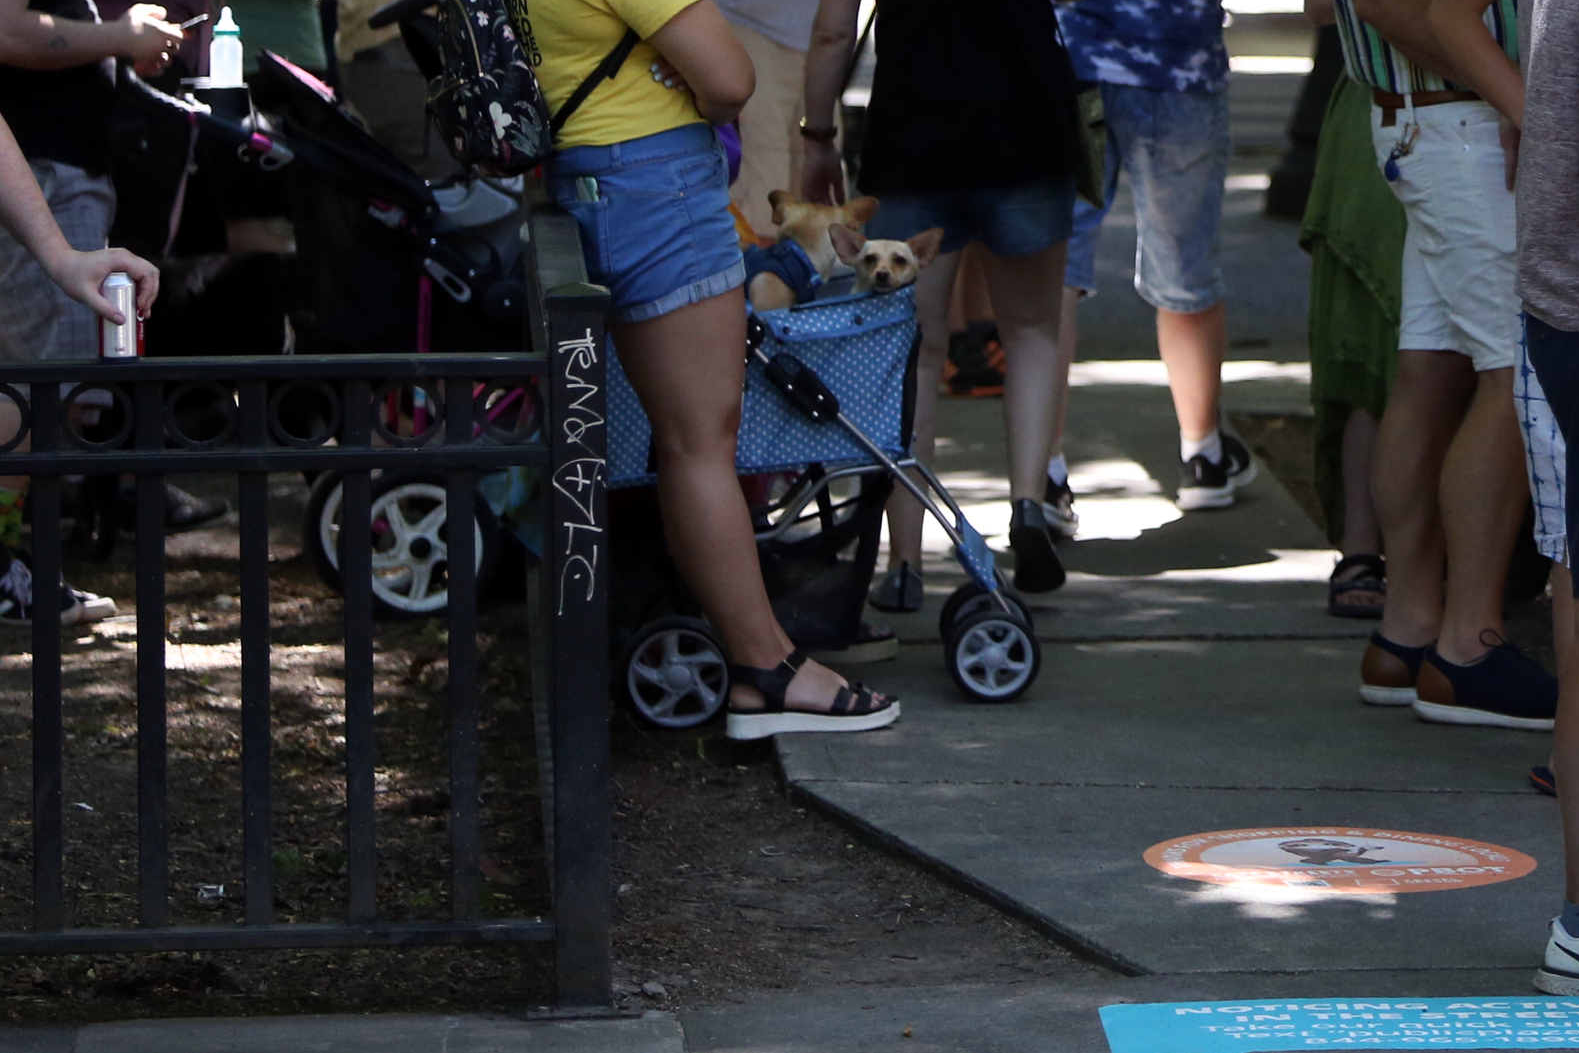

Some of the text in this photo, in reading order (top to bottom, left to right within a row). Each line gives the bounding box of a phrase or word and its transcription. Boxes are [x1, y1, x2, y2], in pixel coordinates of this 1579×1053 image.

[1208, 829, 1337, 841] SHOPPING
[1372, 832, 1465, 847] DINING
[1406, 866, 1505, 875] PBOT
[1174, 1003, 1428, 1015] NOTICING
[1236, 1014, 1292, 1022] IN
[1199, 1024, 1296, 1032] Take
[1398, 1021, 1511, 1030] quick
[1223, 1031, 1316, 1039] Text
